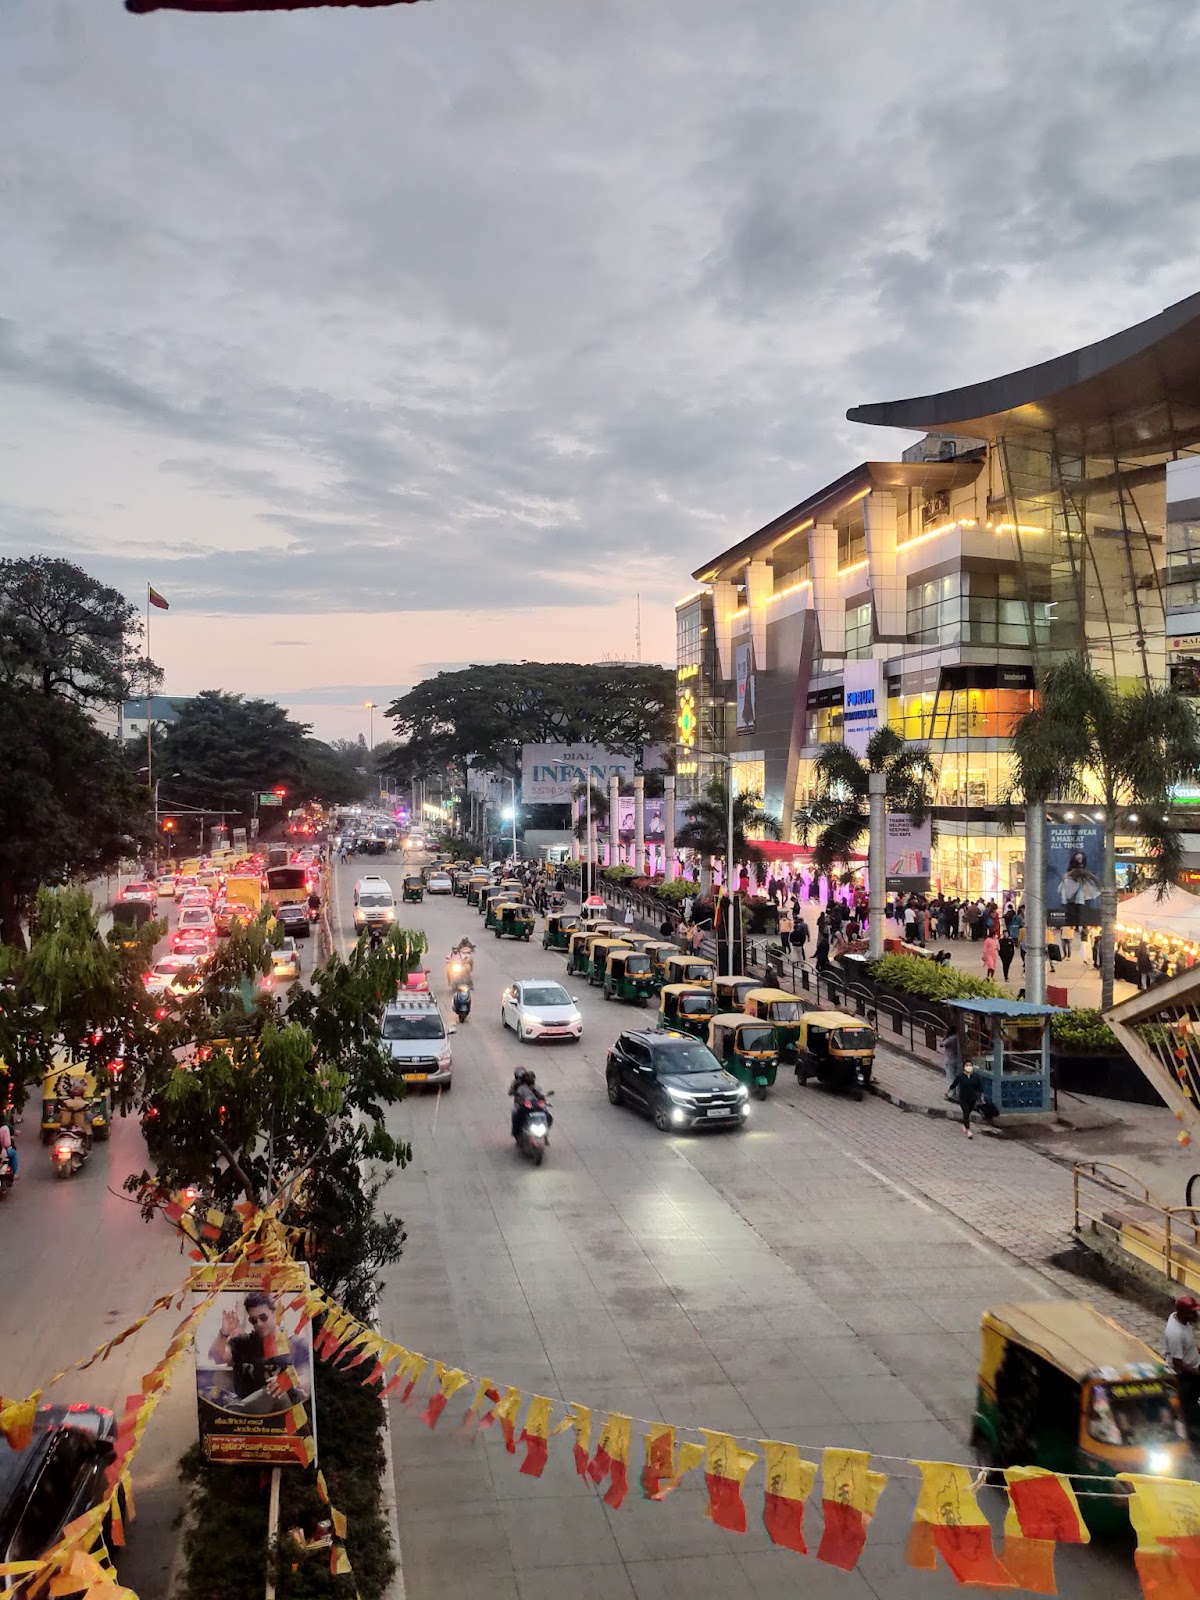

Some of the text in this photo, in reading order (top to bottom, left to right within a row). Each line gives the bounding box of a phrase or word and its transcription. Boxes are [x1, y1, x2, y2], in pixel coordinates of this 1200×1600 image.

[847, 689, 874, 706] FORUM
[563, 753, 594, 761] DIAL
[531, 765, 626, 782] INFANT
